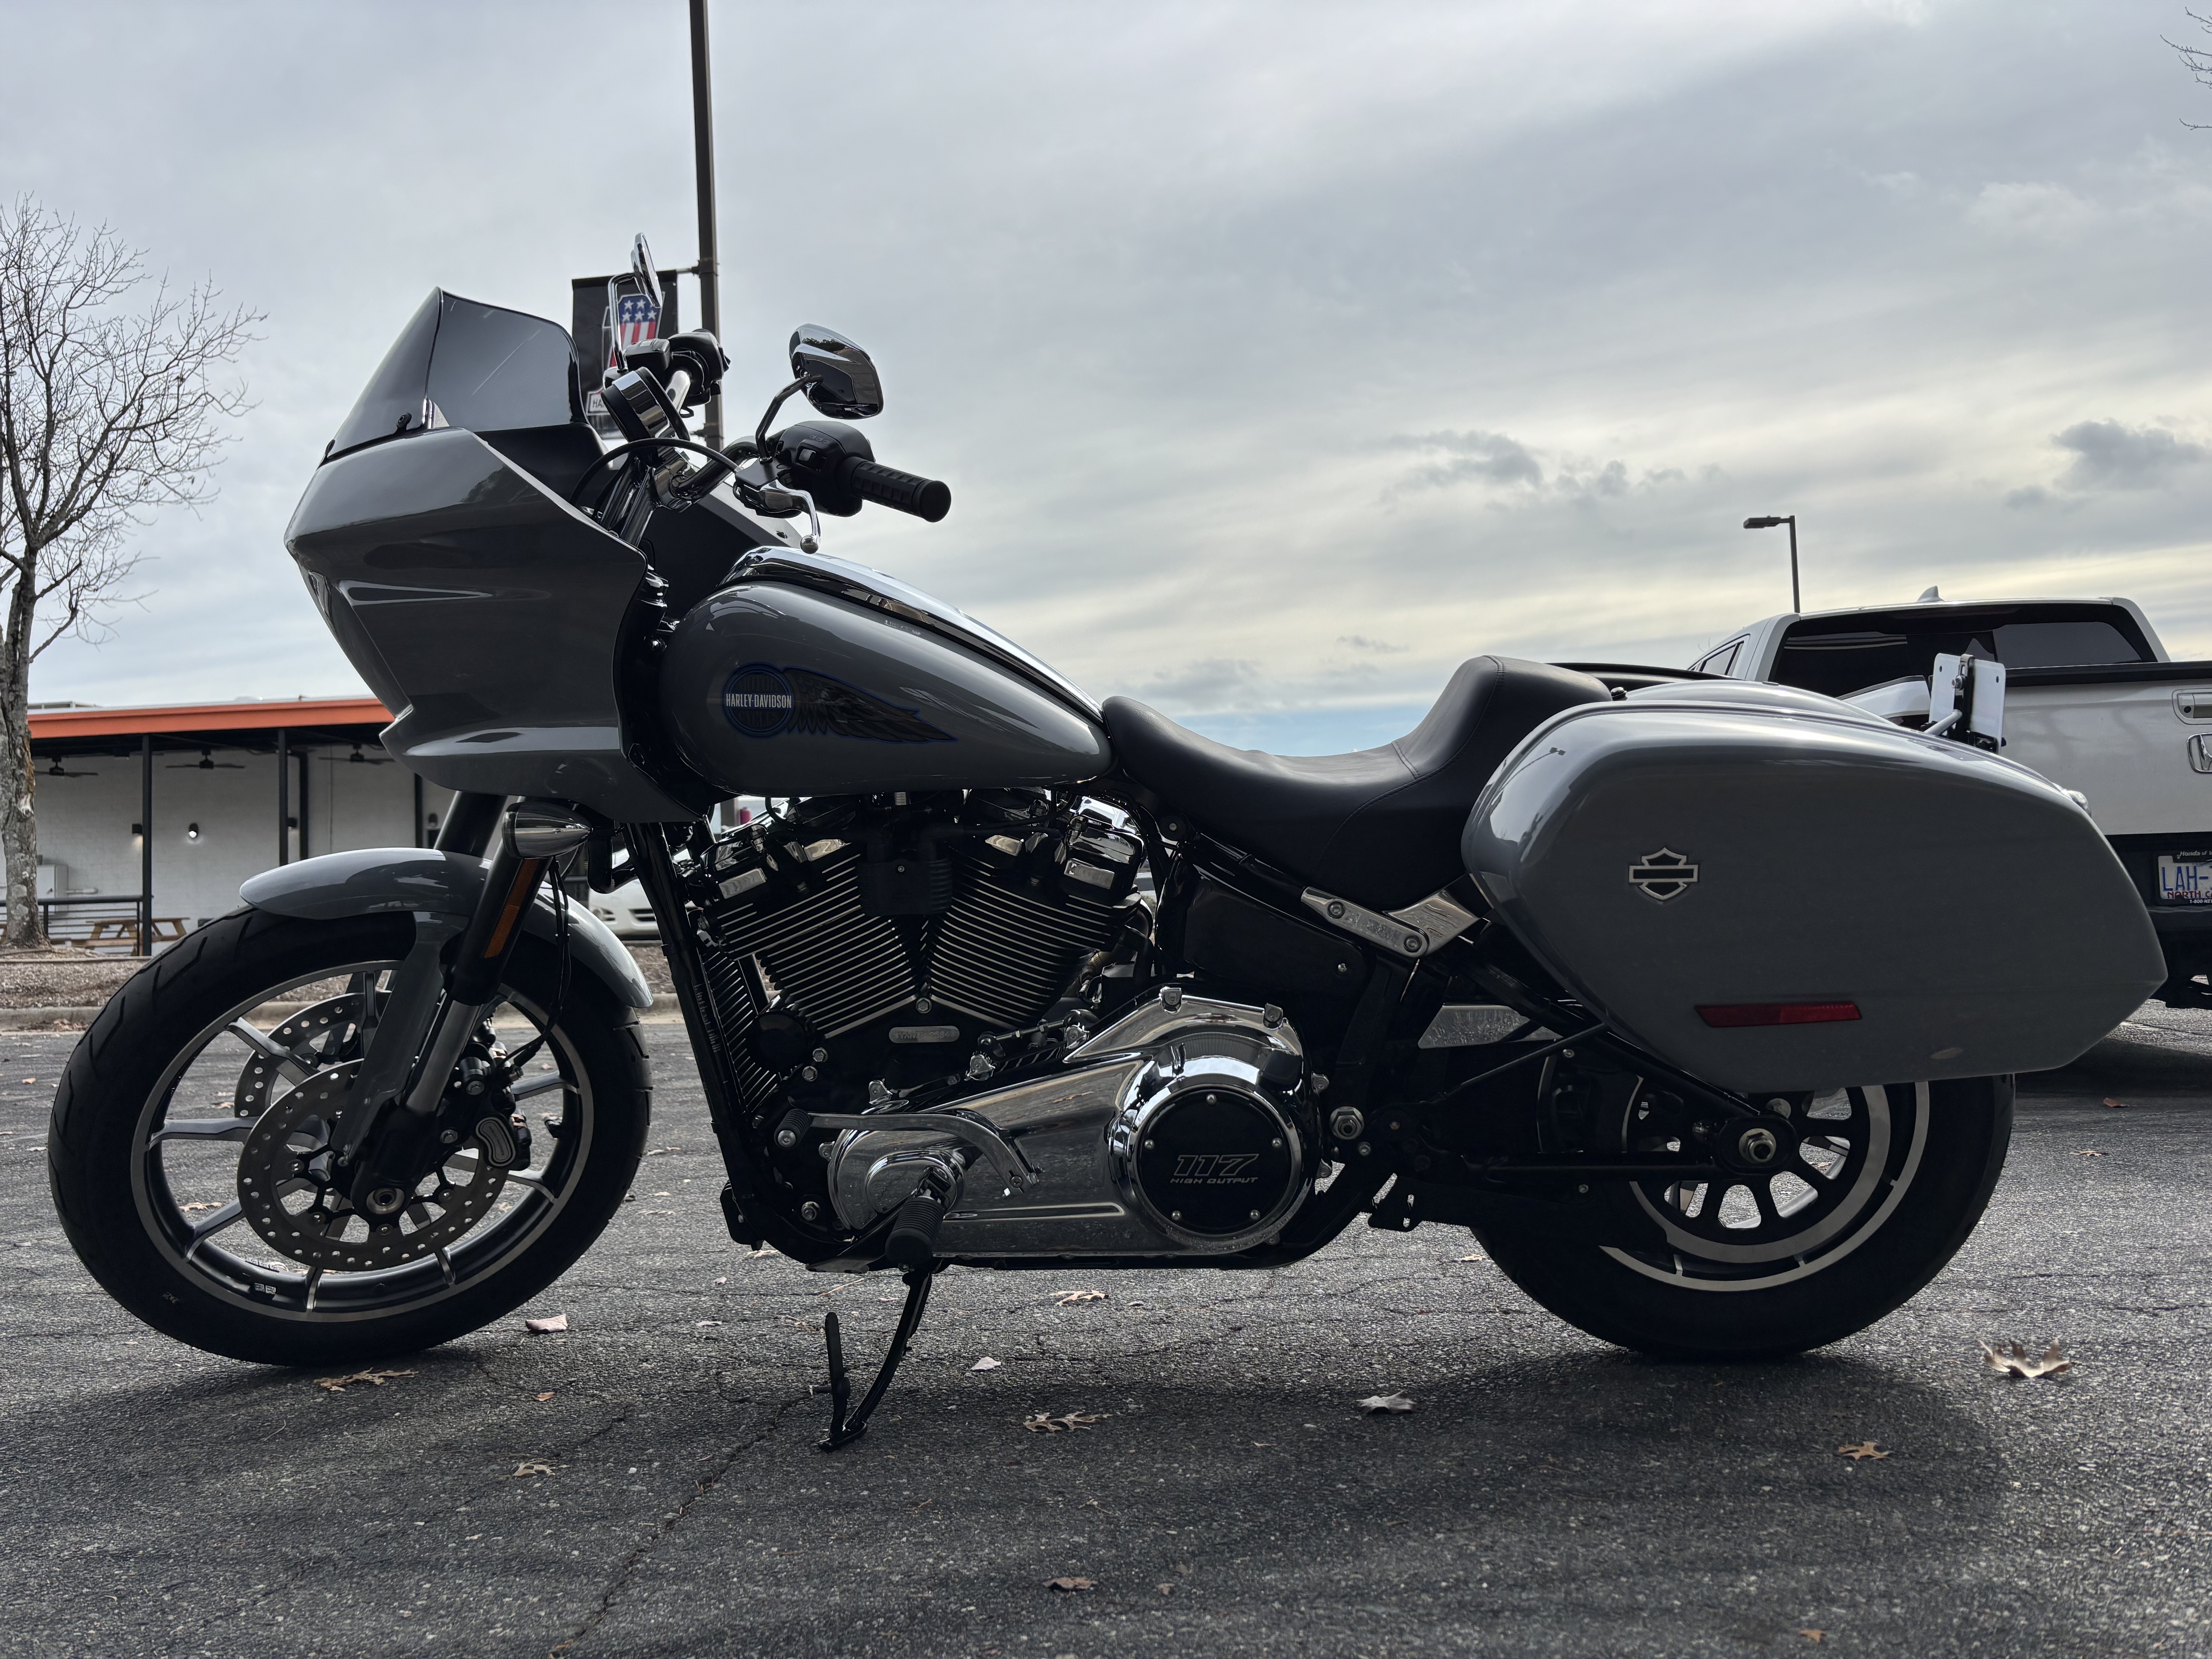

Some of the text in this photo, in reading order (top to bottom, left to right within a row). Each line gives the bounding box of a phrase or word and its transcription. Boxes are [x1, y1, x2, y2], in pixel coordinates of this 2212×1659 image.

[726, 694, 792, 708] HARLEY-DAVIDSON
[2162, 866, 2212, 891] LAH-
[1174, 1154, 1259, 1176] 117
